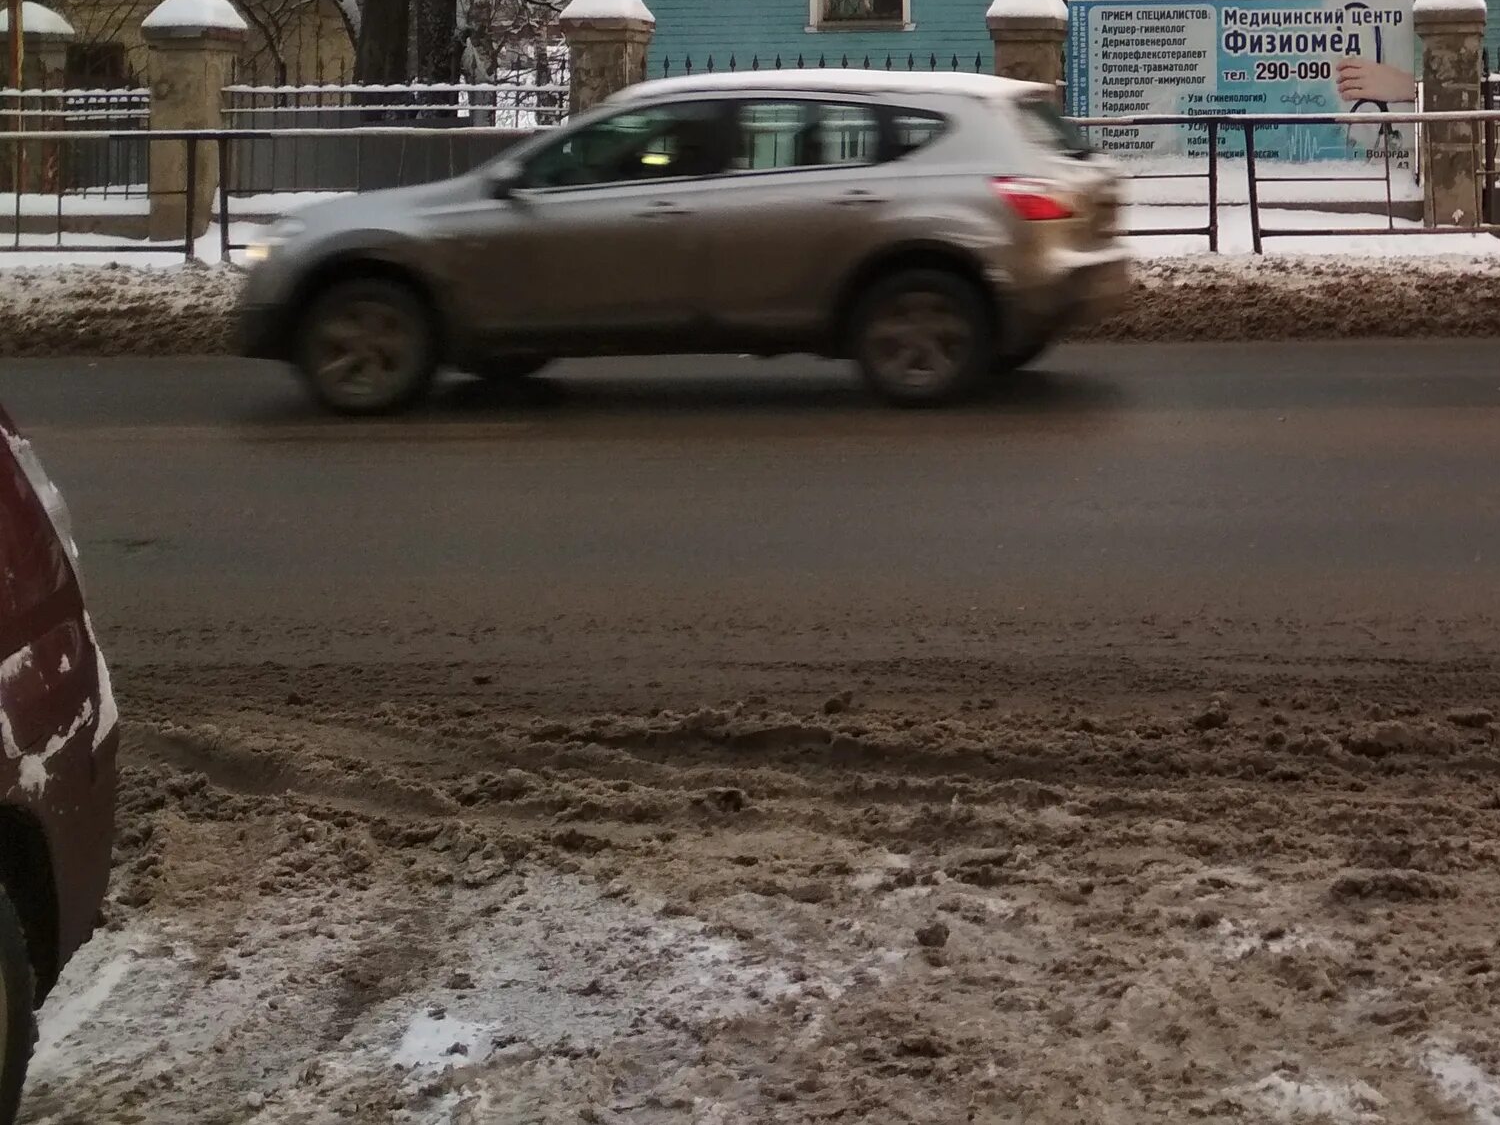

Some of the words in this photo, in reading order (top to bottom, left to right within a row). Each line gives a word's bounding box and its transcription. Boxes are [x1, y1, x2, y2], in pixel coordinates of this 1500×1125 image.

[1101, 11, 1133, 21] ПРИЕМ
[1136, 9, 1211, 21] СПЕЦИАЛИСТОВ:
[1224, 8, 1344, 27] Медицинский
[1352, 10, 1403, 27] центр
[1101, 24, 1186, 35] Акушер-гинеколог
[1102, 37, 1187, 48] Дерматовенеролог
[1224, 29, 1361, 55] Физиомед
[1102, 49, 1208, 61] Иглорефлексотерапевт
[1102, 62, 1199, 74] Ортопед-травматолог
[1223, 70, 1249, 81] тел.
[1256, 61, 1331, 81] 290-090
[1102, 75, 1207, 87] Аллерголог-иммунолог
[1102, 88, 1144, 100] Невролог
[1187, 93, 1203, 104] Узи
[1206, 92, 1267, 104] (гинекология)
[1102, 101, 1151, 112] Кардиолог
[1102, 127, 1139, 138] Педиатр
[1102, 140, 1155, 150] Ревматолог
[1187, 135, 1227, 146] кабита
[1366, 149, 1410, 159] Вологда
